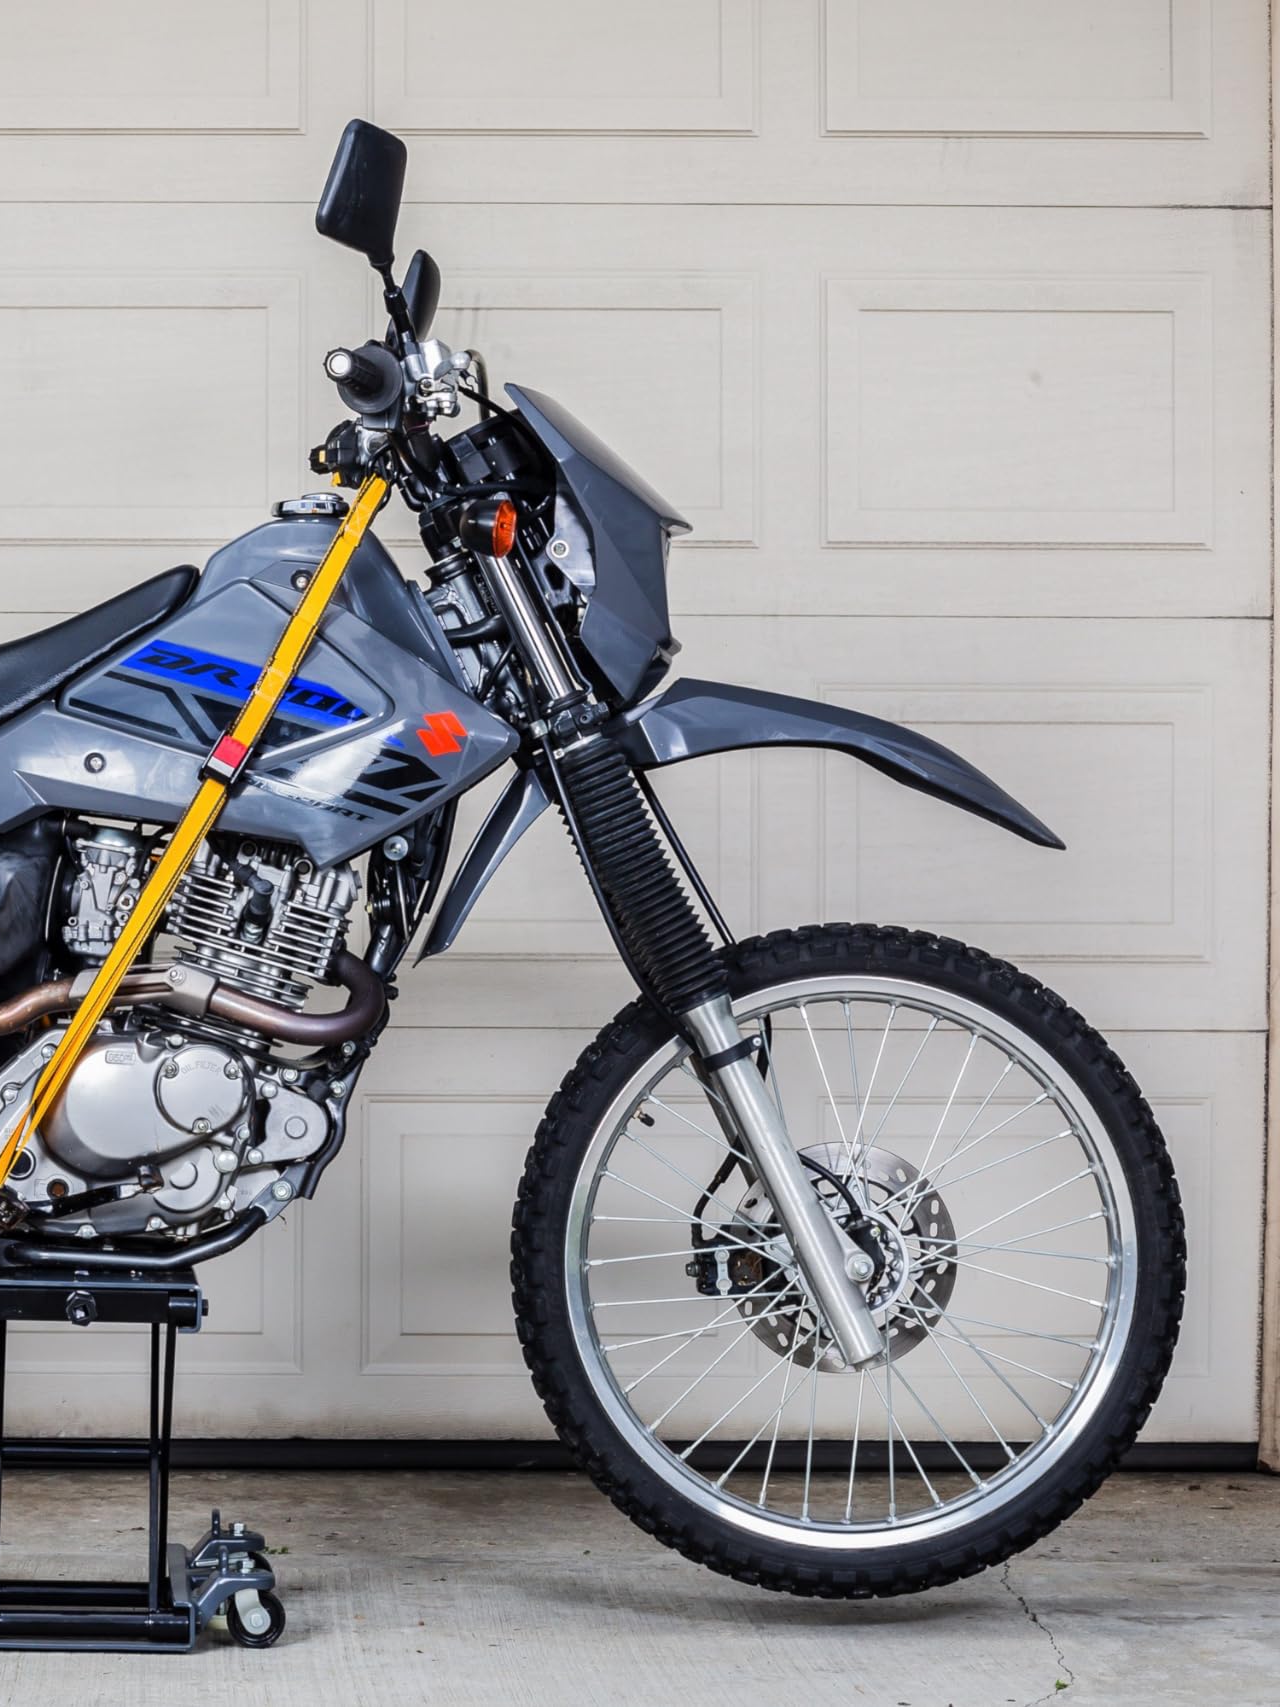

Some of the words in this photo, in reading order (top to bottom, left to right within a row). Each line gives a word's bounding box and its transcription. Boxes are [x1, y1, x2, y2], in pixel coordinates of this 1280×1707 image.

[139, 647, 240, 687] DR
[245, 684, 370, 721] 00
[180, 1064, 195, 1075] OIL
[195, 1060, 222, 1076] FILTER
